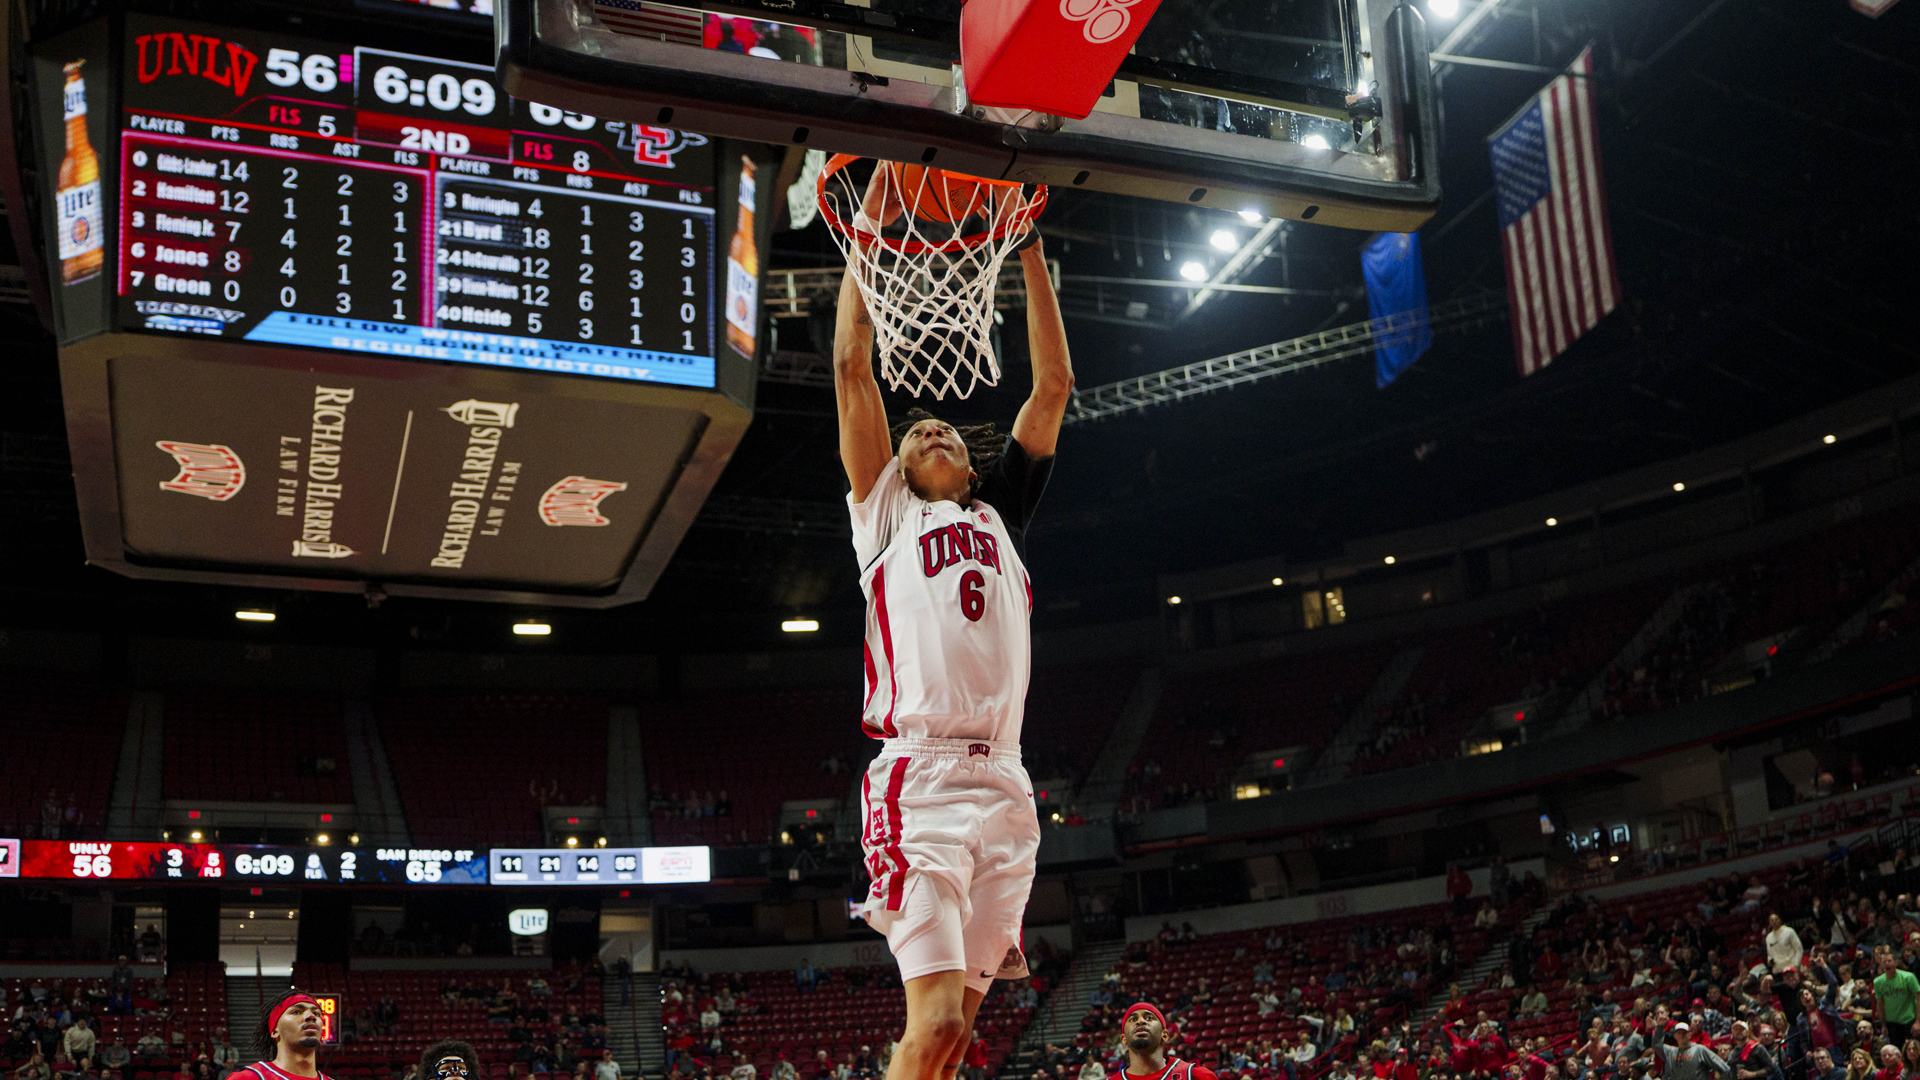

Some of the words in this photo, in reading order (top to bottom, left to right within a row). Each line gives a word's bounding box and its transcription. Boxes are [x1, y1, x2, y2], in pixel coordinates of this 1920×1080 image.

[134, 33, 259, 97] UNLV
[265, 48, 338, 92] 56
[374, 66, 496, 115] 6:09
[269, 105, 300, 125] FLS
[318, 115, 336, 137] 5
[131, 115, 185, 134] PLAYER
[211, 126, 240, 141] PTS
[270, 134, 299, 149] RBS
[333, 143, 360, 158] AST
[394, 151, 419, 166] FLS
[400, 126, 470, 155] 2ND
[523, 141, 553, 160] FLS
[573, 151, 590, 172] 8
[132, 150, 148, 167] 0
[219, 159, 250, 182] 14
[282, 167, 298, 189] 2
[337, 174, 353, 196] 2
[393, 181, 409, 203] 3
[439, 157, 490, 175] PLAYER
[512, 166, 540, 181] PTS
[566, 174, 593, 189] RBS
[623, 182, 649, 196] AST
[679, 189, 702, 204] FLS
[132, 180, 146, 196] 2
[219, 190, 249, 213] 12
[284, 197, 297, 219] 1
[339, 204, 352, 226] 1
[393, 211, 407, 233] 1
[443, 192, 457, 208] 3
[527, 198, 544, 219] 4
[580, 205, 594, 226] 1
[629, 211, 644, 232] 3
[682, 218, 695, 239] 1
[131, 211, 145, 227] 3
[225, 221, 241, 242] 7
[280, 228, 297, 249] 4
[337, 235, 352, 256] 2
[393, 241, 407, 263] 1
[438, 220, 462, 237] 21
[463, 220, 503, 241] Byrd
[522, 226, 550, 249] 18
[580, 234, 594, 255] 1
[629, 240, 644, 261] 2
[680, 247, 696, 268] 3
[131, 242, 146, 258] 6
[155, 245, 209, 267] Jones
[224, 250, 241, 272] 8
[280, 257, 297, 278] 4
[338, 263, 351, 285] 1
[391, 269, 407, 291] 2
[437, 248, 462, 266] 24
[522, 256, 550, 279] 12
[579, 263, 594, 284] 2
[629, 269, 644, 290] 3
[682, 275, 695, 296] 1
[130, 270, 145, 287] 7
[155, 273, 211, 296] Green
[224, 280, 241, 302] 0
[280, 286, 297, 307] 0
[335, 292, 351, 314] 3
[393, 298, 406, 320] 1
[437, 276, 462, 293] 39
[522, 283, 550, 307] 12
[578, 290, 594, 311] 6
[630, 297, 643, 317] 1
[680, 302, 696, 323] 0
[289, 315, 408, 334] FOLLOW
[421, 328, 540, 349] WINTER
[436, 304, 462, 321] 40
[462, 305, 512, 327] Heide
[528, 312, 542, 334] 5
[578, 318, 594, 339] 3
[630, 324, 643, 345] 1
[682, 330, 695, 351] 1
[331, 336, 449, 359] SECURE
[309, 385, 355, 481] RICHARD
[280, 436, 301, 472] LAW
[449, 427, 502, 500] HARRIS
[276, 478, 298, 517] FIRM
[490, 461, 522, 501] FIRM
[302, 481, 343, 542] HARRIS
[480, 506, 505, 536] LAW
[431, 500, 480, 568] RICHARD
[960, 569, 985, 622] 6
[69, 842, 112, 855] UNLV
[72, 855, 112, 877] 56
[167, 848, 183, 867] 3
[207, 852, 220, 867] 5
[235, 854, 294, 875] 6:09
[307, 854, 320, 868] 8
[340, 851, 357, 870] 2
[376, 849, 406, 861] SAN
[408, 849, 452, 862] DIEGO
[454, 850, 474, 862] ST
[501, 857, 522, 872] 11
[539, 857, 560, 872] 21
[577, 857, 599, 871] 14
[203, 867, 222, 878] FLS
[304, 868, 322, 879] FLS
[405, 861, 442, 882] 65
[853, 946, 881, 963] 102
